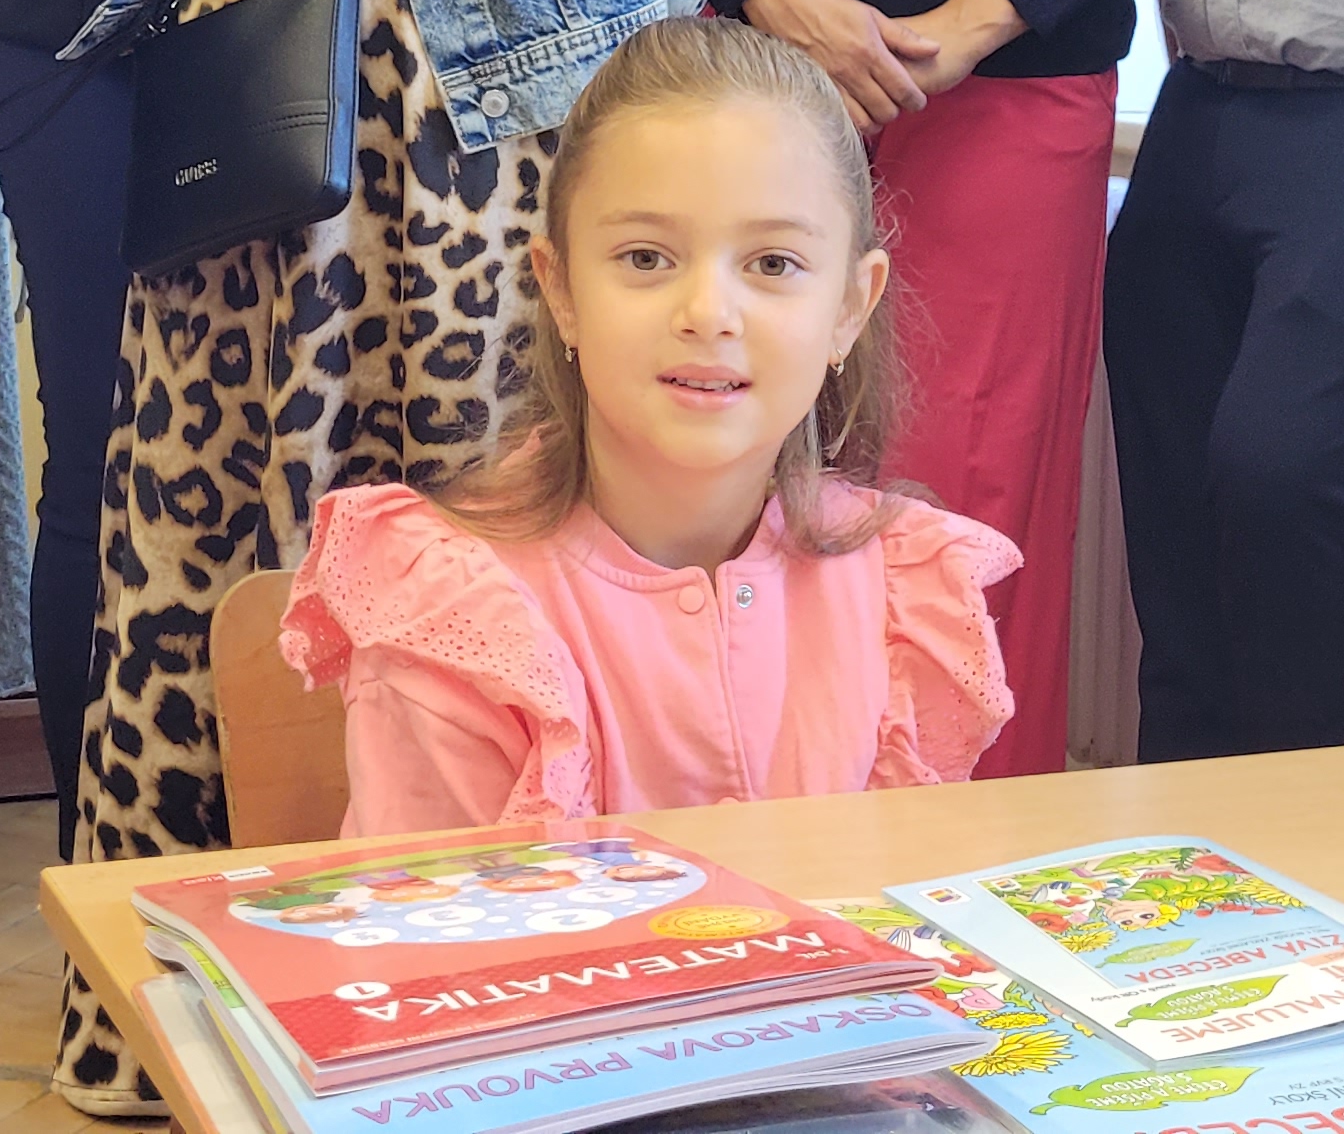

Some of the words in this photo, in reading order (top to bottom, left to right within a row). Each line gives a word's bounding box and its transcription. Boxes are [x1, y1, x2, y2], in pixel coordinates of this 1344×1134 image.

[352, 932, 826, 1022] MATEMATIKA
[1125, 947, 1267, 984] ABECEDA
[637, 1003, 932, 1061] OSKAROVA
[352, 1052, 633, 1124] PRVOUKA
[1269, 1090, 1329, 1106] ŠKOLY
